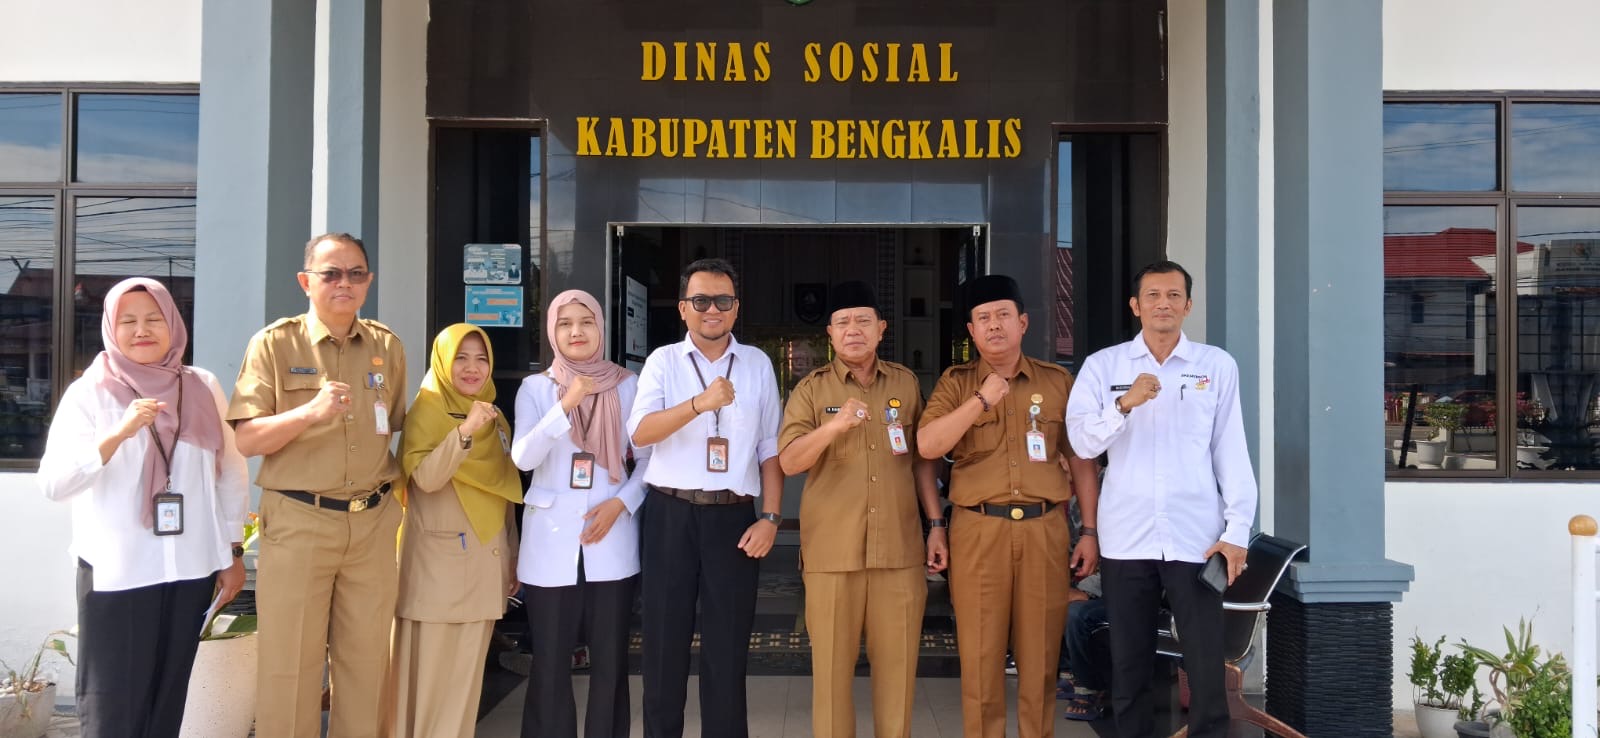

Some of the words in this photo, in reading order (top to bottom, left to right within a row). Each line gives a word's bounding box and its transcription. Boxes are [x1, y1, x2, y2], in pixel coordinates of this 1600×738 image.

[640, 41, 771, 82] DINAS
[803, 41, 959, 83] SOSIAL
[575, 116, 797, 159] KABUPATEN
[809, 117, 1022, 160] BENGKALIS
